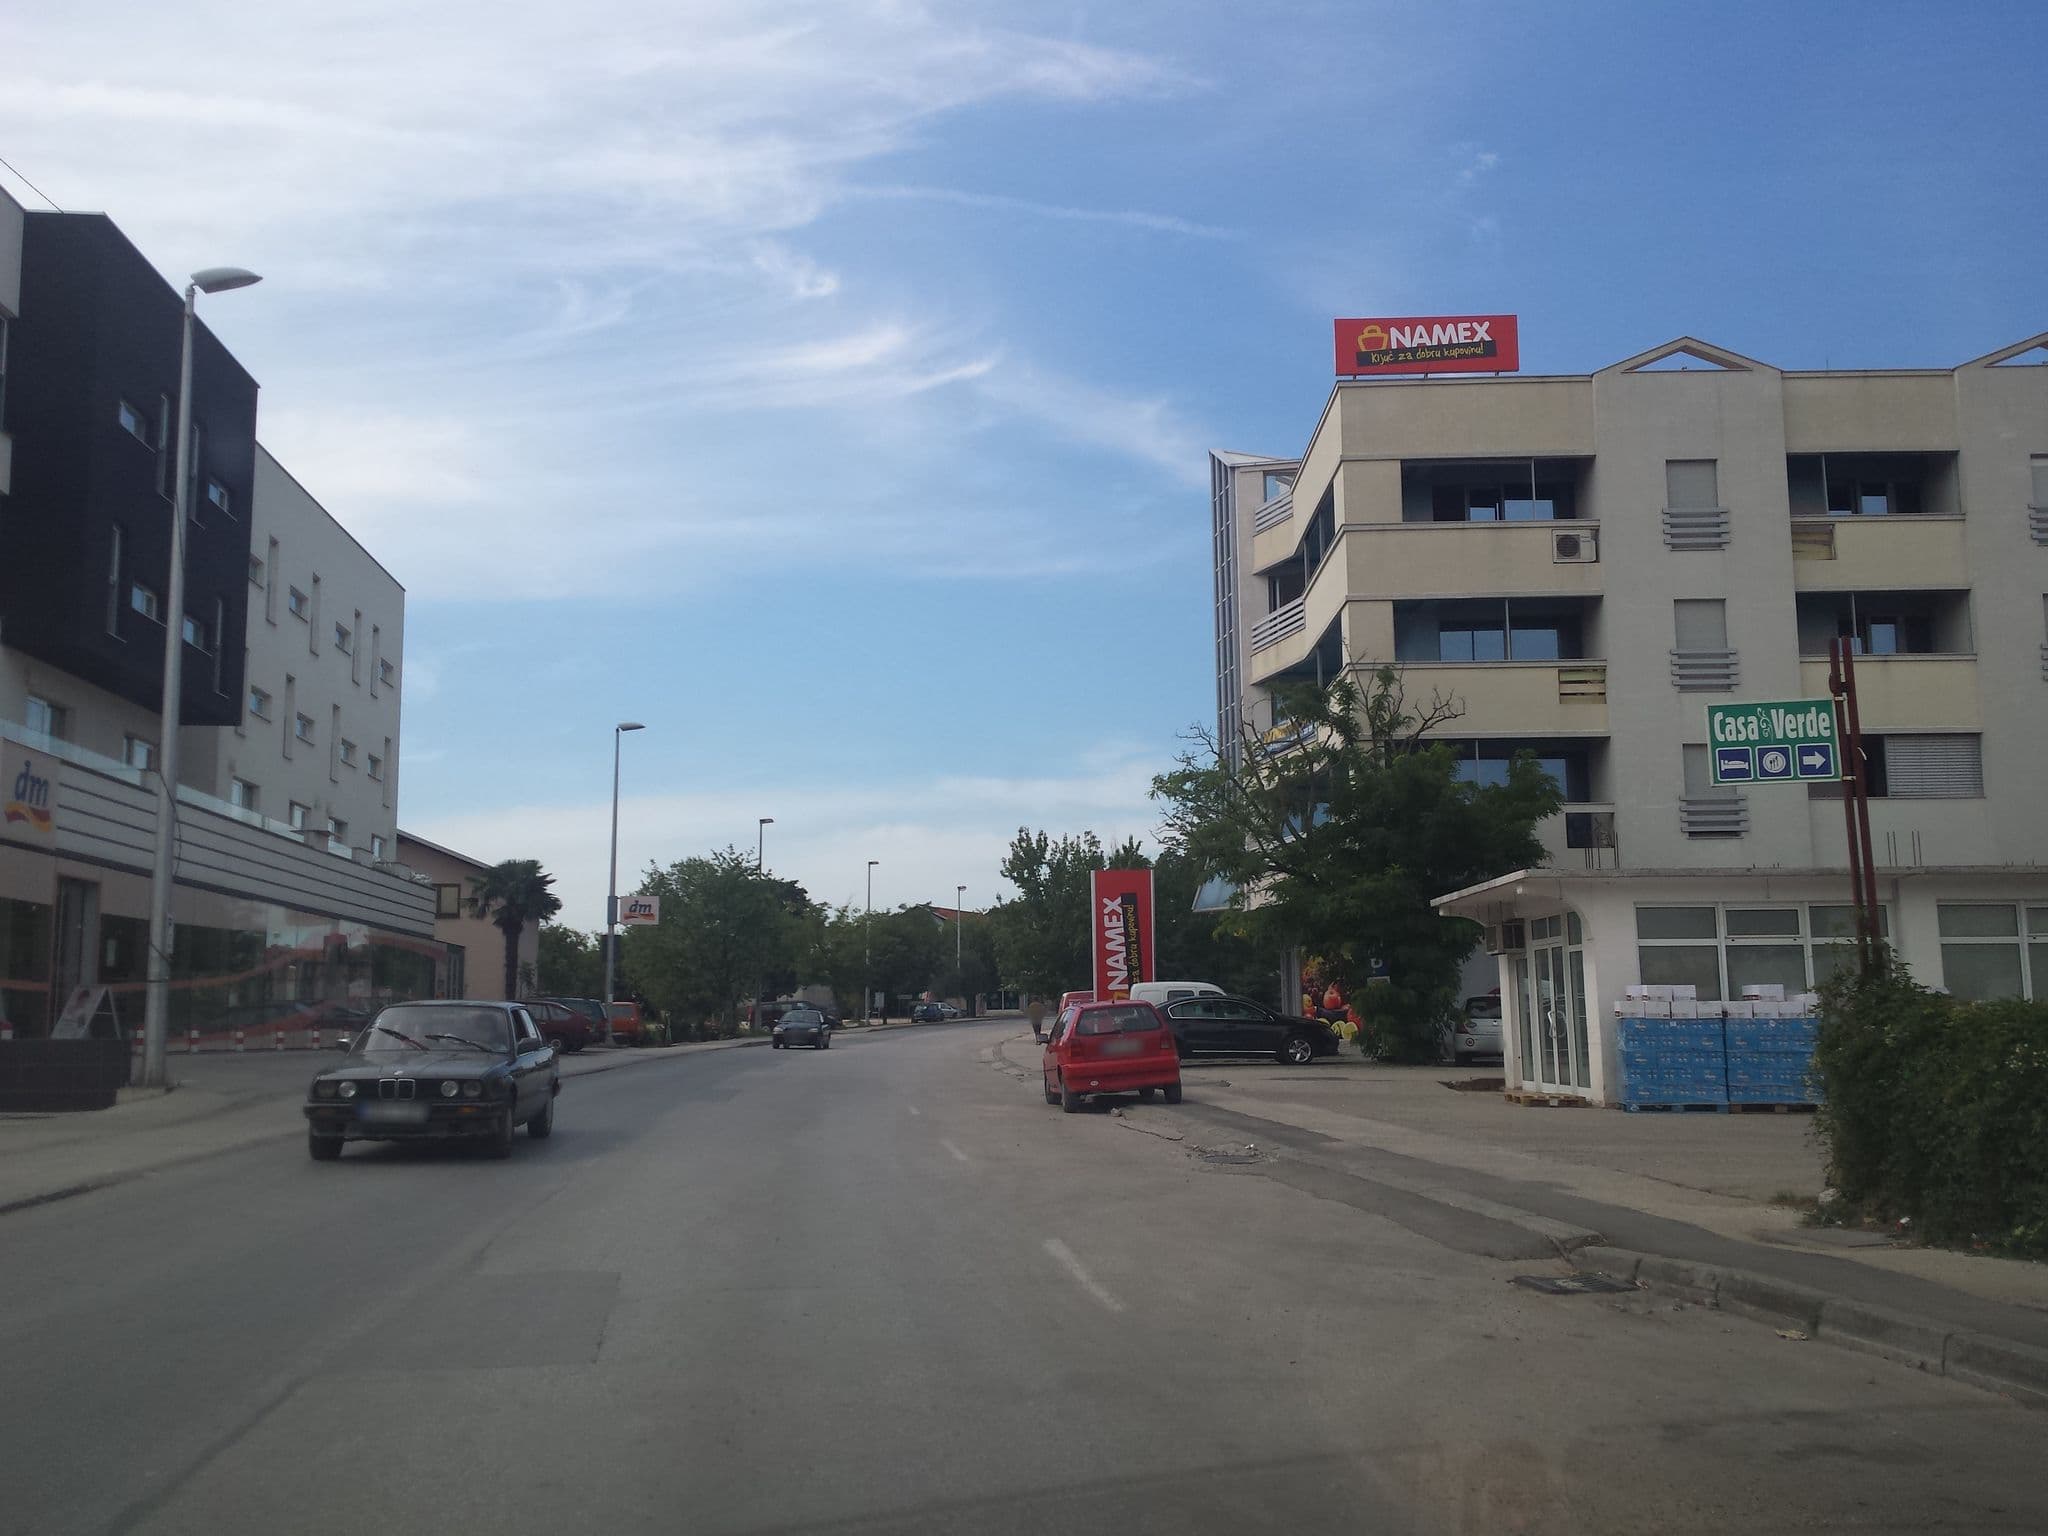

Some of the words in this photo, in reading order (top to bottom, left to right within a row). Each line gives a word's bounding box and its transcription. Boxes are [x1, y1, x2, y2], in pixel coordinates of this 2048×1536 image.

[1389, 321, 1492, 349] NAMEX
[1398, 352, 1413, 361] za
[1416, 347, 1441, 359] dobru
[1714, 712, 1759, 741] Casa
[1770, 706, 1831, 739] Verde
[15, 760, 48, 808] dm
[629, 900, 652, 913] dm
[1103, 896, 1129, 990] NAMEX
